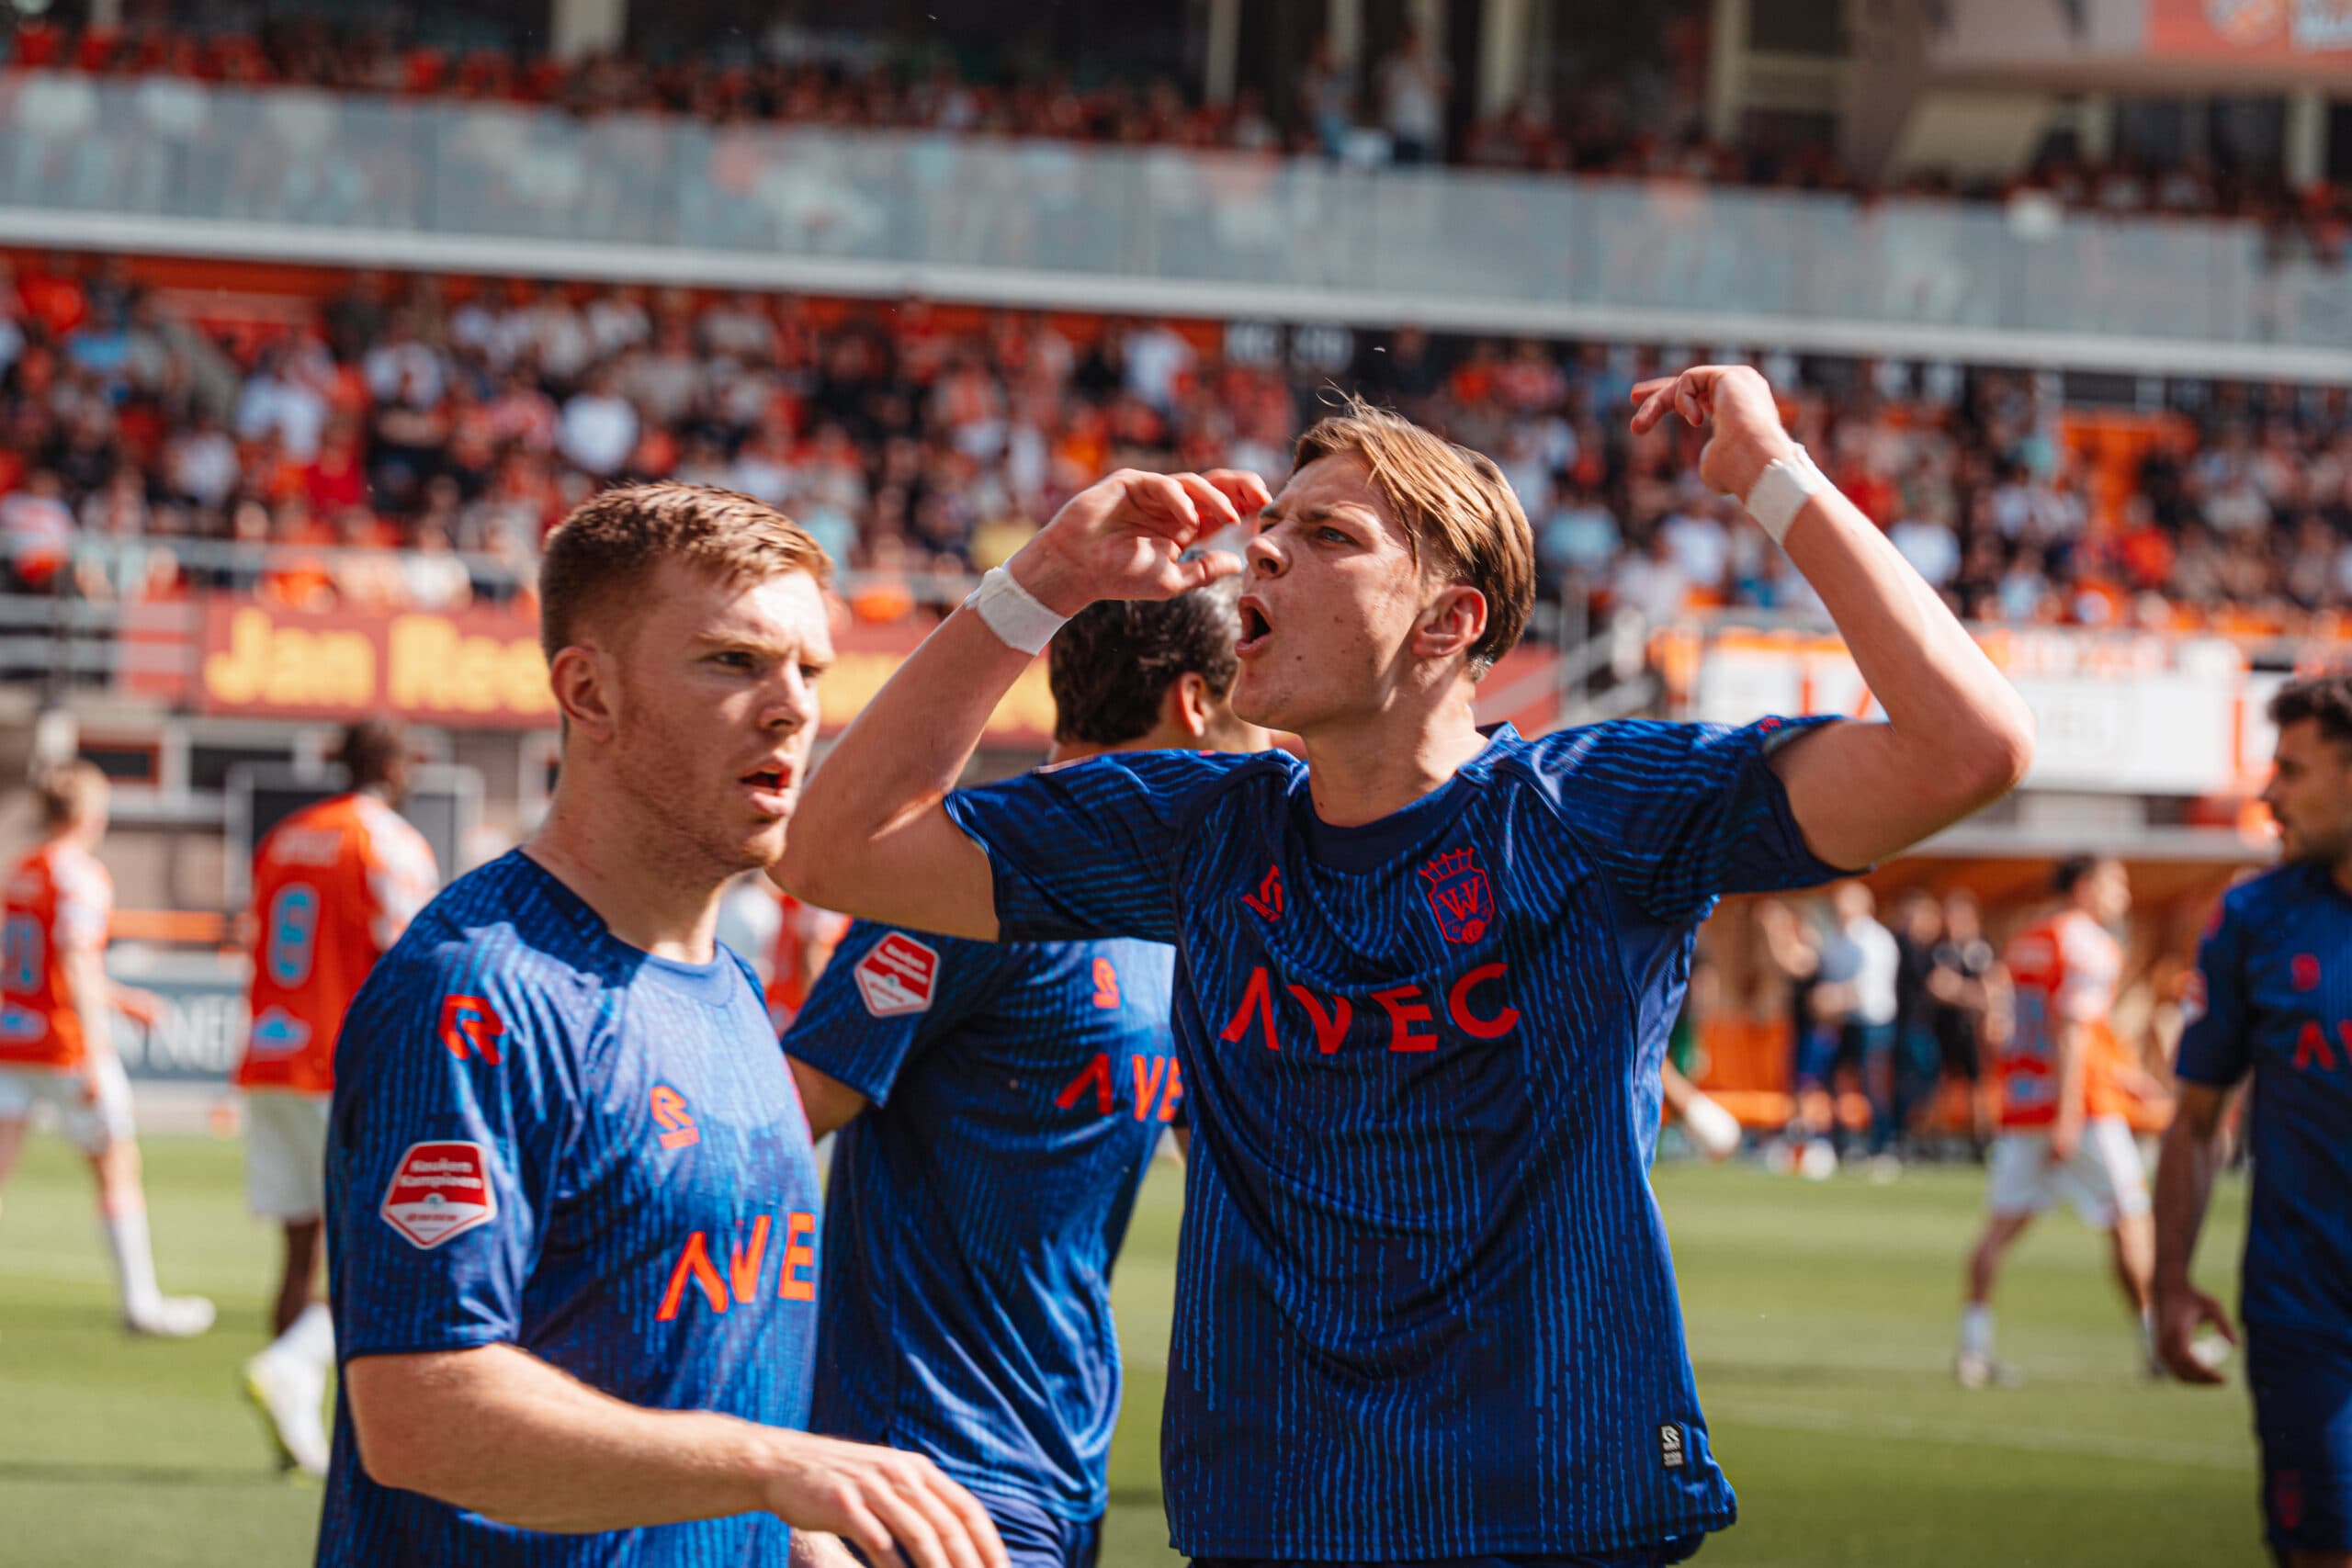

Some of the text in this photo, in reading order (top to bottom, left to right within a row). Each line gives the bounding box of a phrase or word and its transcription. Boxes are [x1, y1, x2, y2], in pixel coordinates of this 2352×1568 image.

[204, 607, 376, 708] Jan
[1220, 963, 1520, 1055] AVEC
[655, 1212, 815, 1321] AVE
